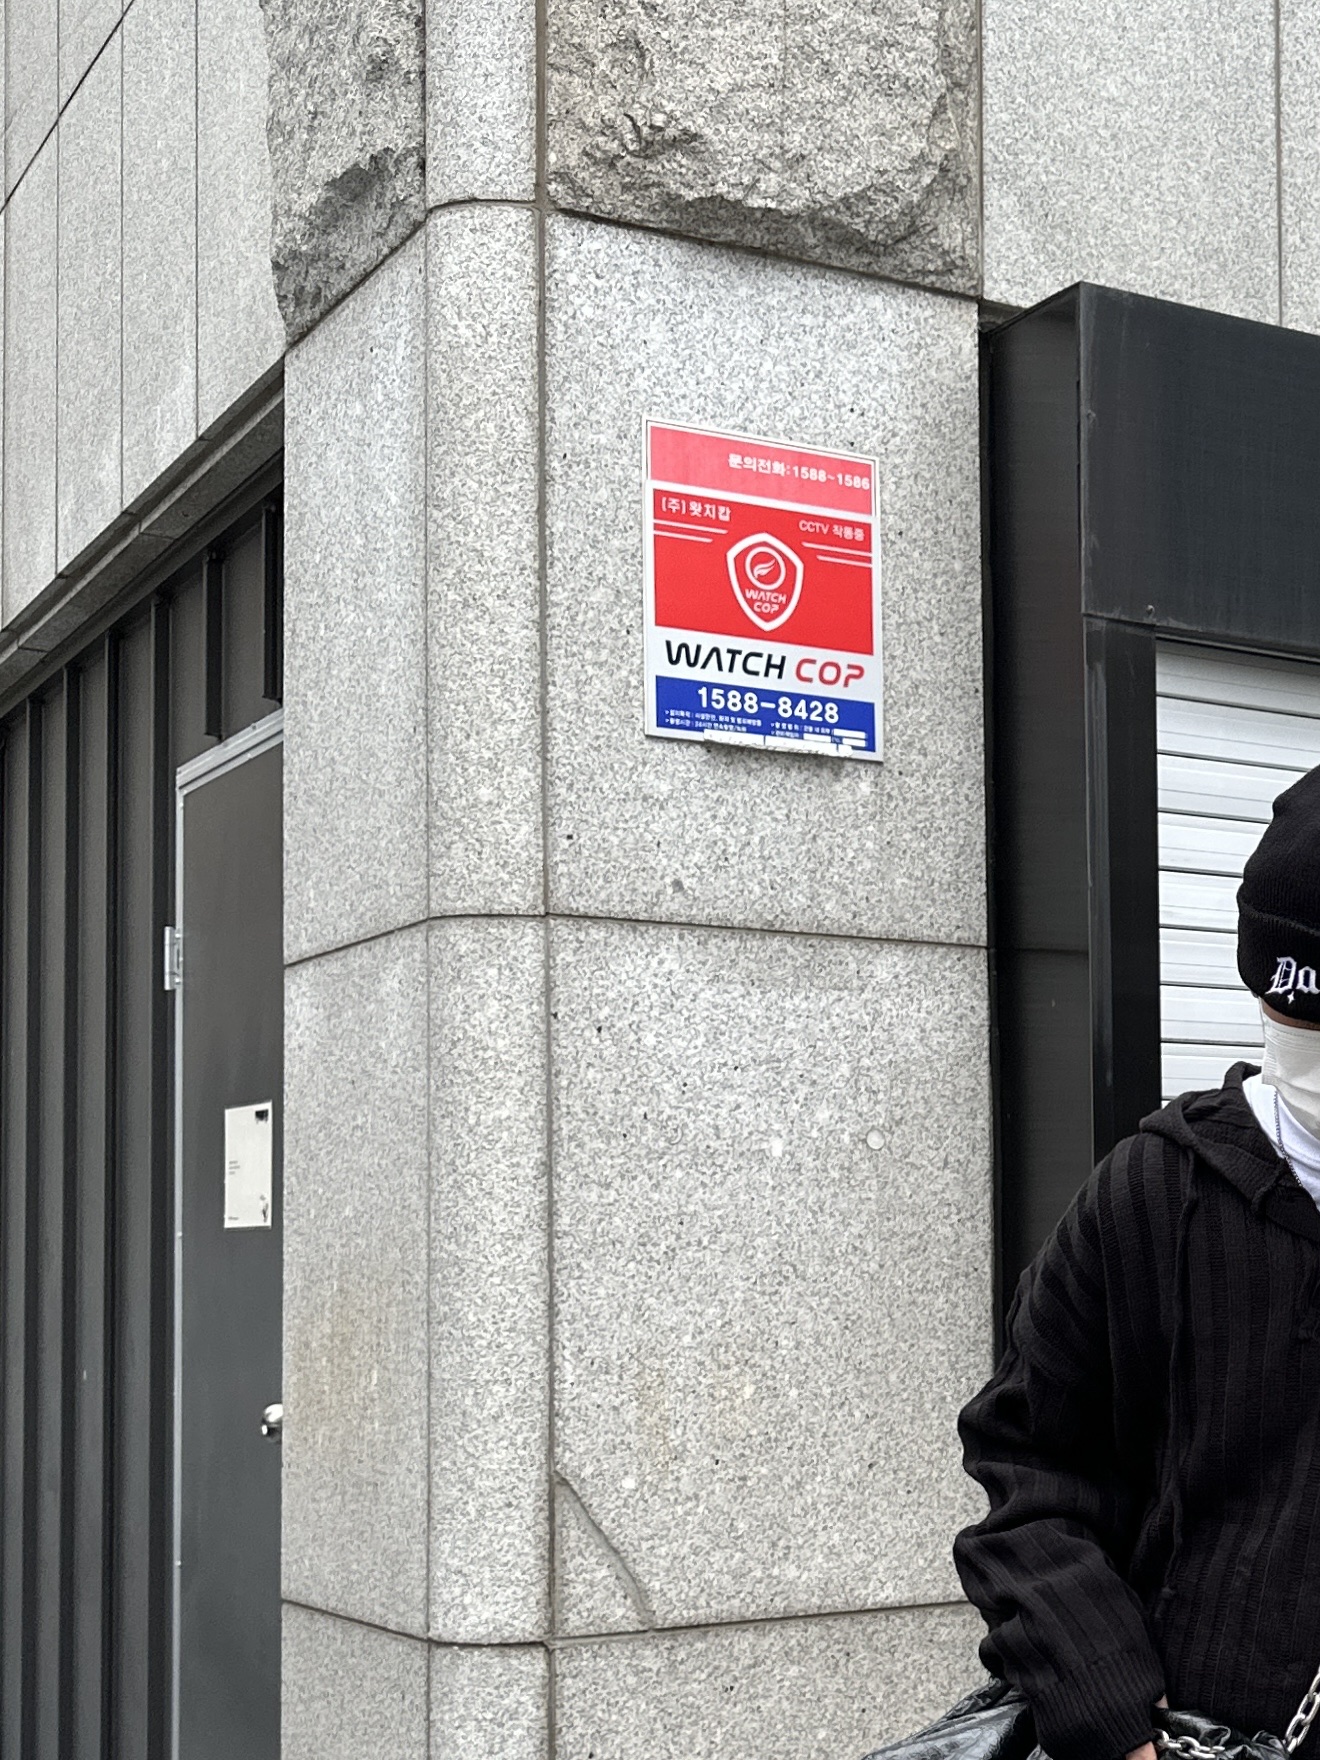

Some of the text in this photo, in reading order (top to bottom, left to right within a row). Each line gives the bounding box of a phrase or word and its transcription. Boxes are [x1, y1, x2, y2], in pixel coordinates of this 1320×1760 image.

[799, 520, 830, 535] CCTV
[745, 588, 787, 605] WATCH
[753, 601, 780, 614] COP
[665, 640, 865, 688] WATCH COP
[697, 686, 839, 724] 1588-8428
